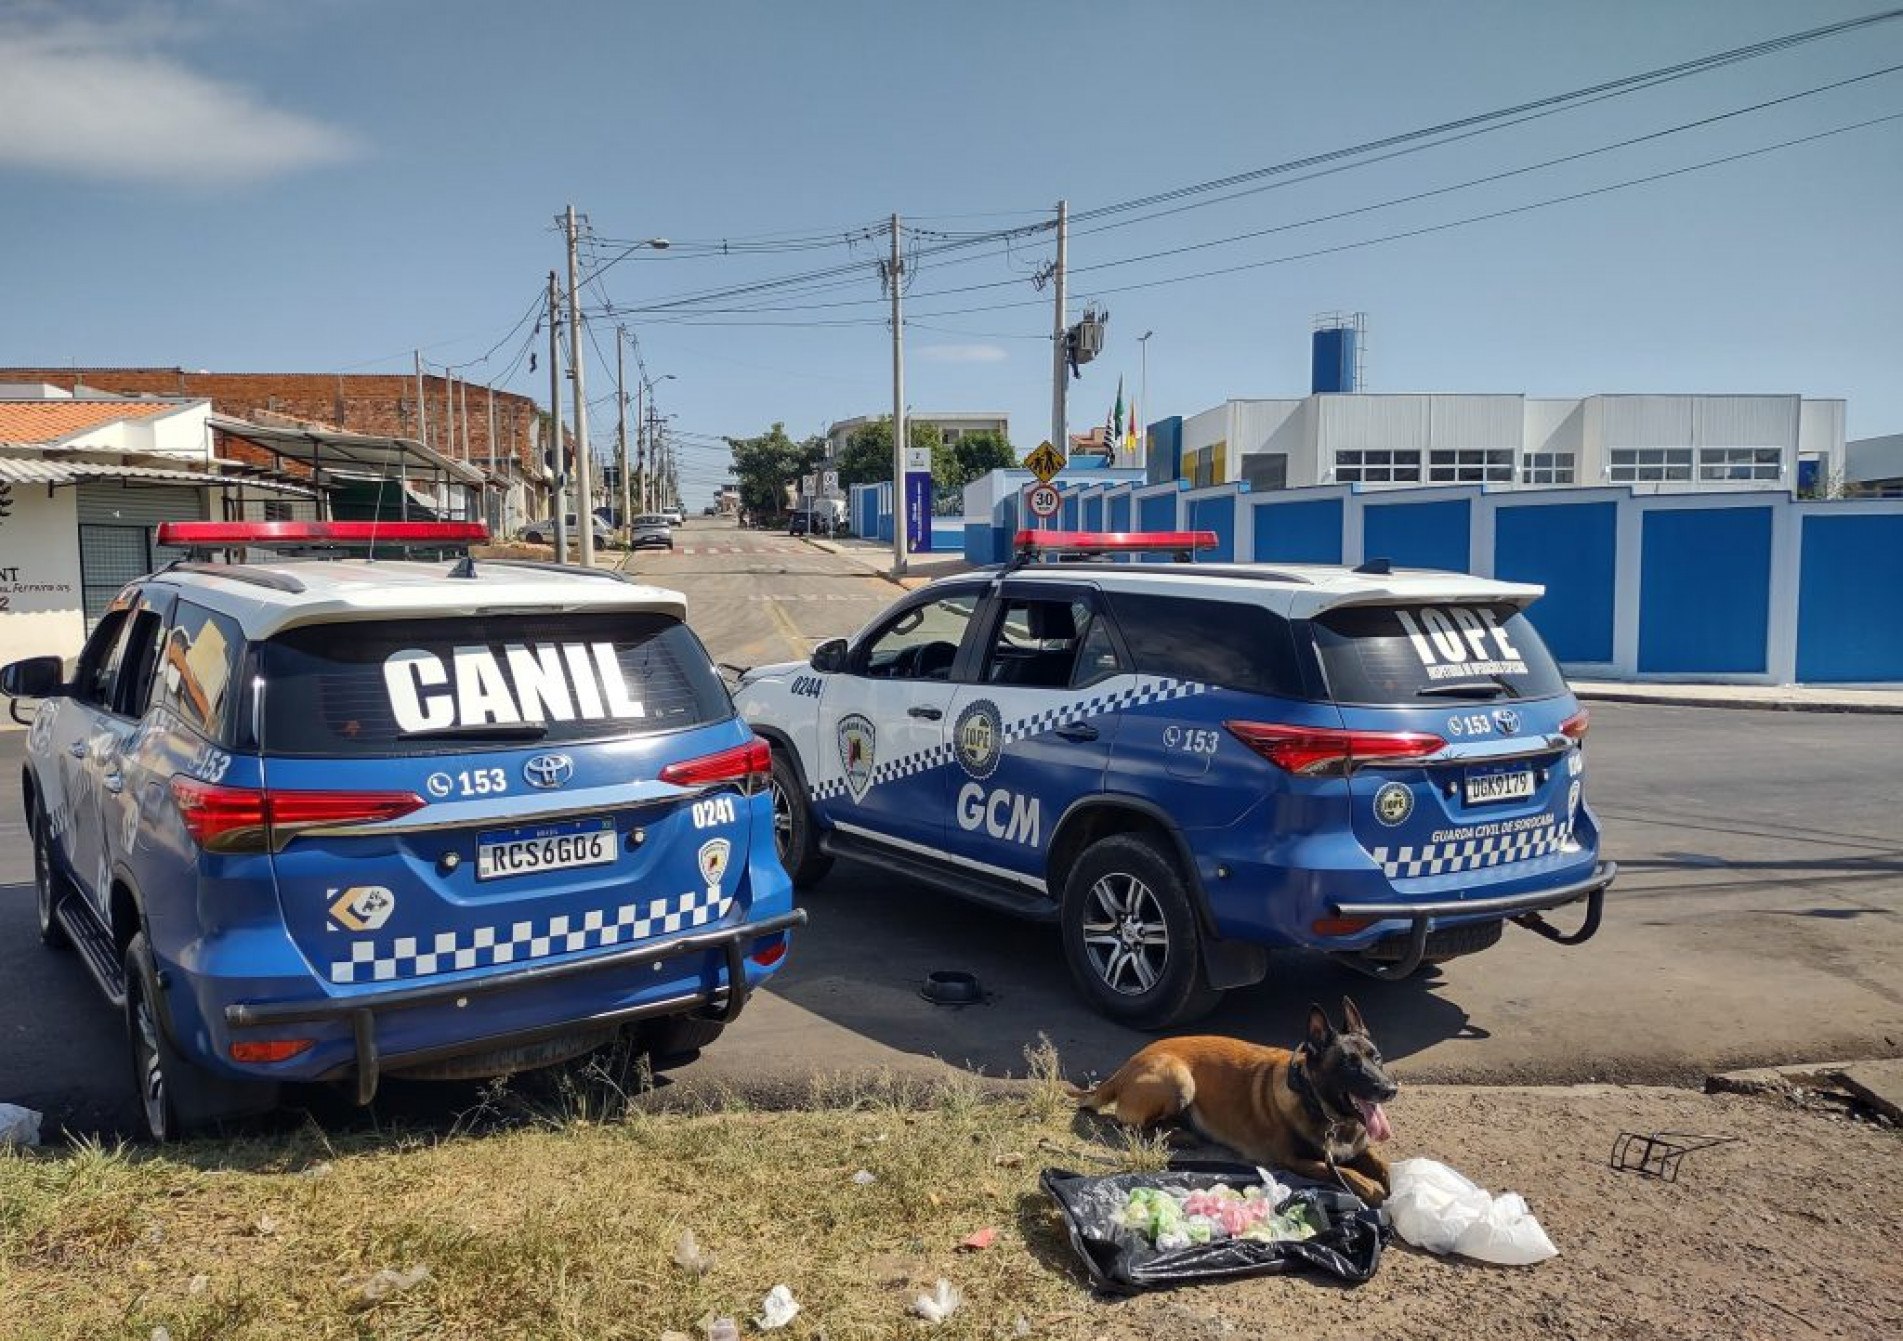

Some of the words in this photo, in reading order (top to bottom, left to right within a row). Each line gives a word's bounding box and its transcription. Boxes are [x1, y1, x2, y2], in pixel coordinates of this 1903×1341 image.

[1036, 492, 1053, 506] 30
[1394, 606, 1521, 665] IOPE
[383, 642, 645, 733] CANIL
[791, 676, 822, 699] 0244
[965, 726, 990, 748] IOPE
[1464, 714, 1491, 735] 153
[1181, 729, 1220, 754] 153
[458, 768, 508, 796] 153
[692, 797, 735, 829] 0241
[956, 781, 1040, 848] GCM
[1432, 827, 1475, 842] GUARDA
[1475, 822, 1500, 838] CIVIL
